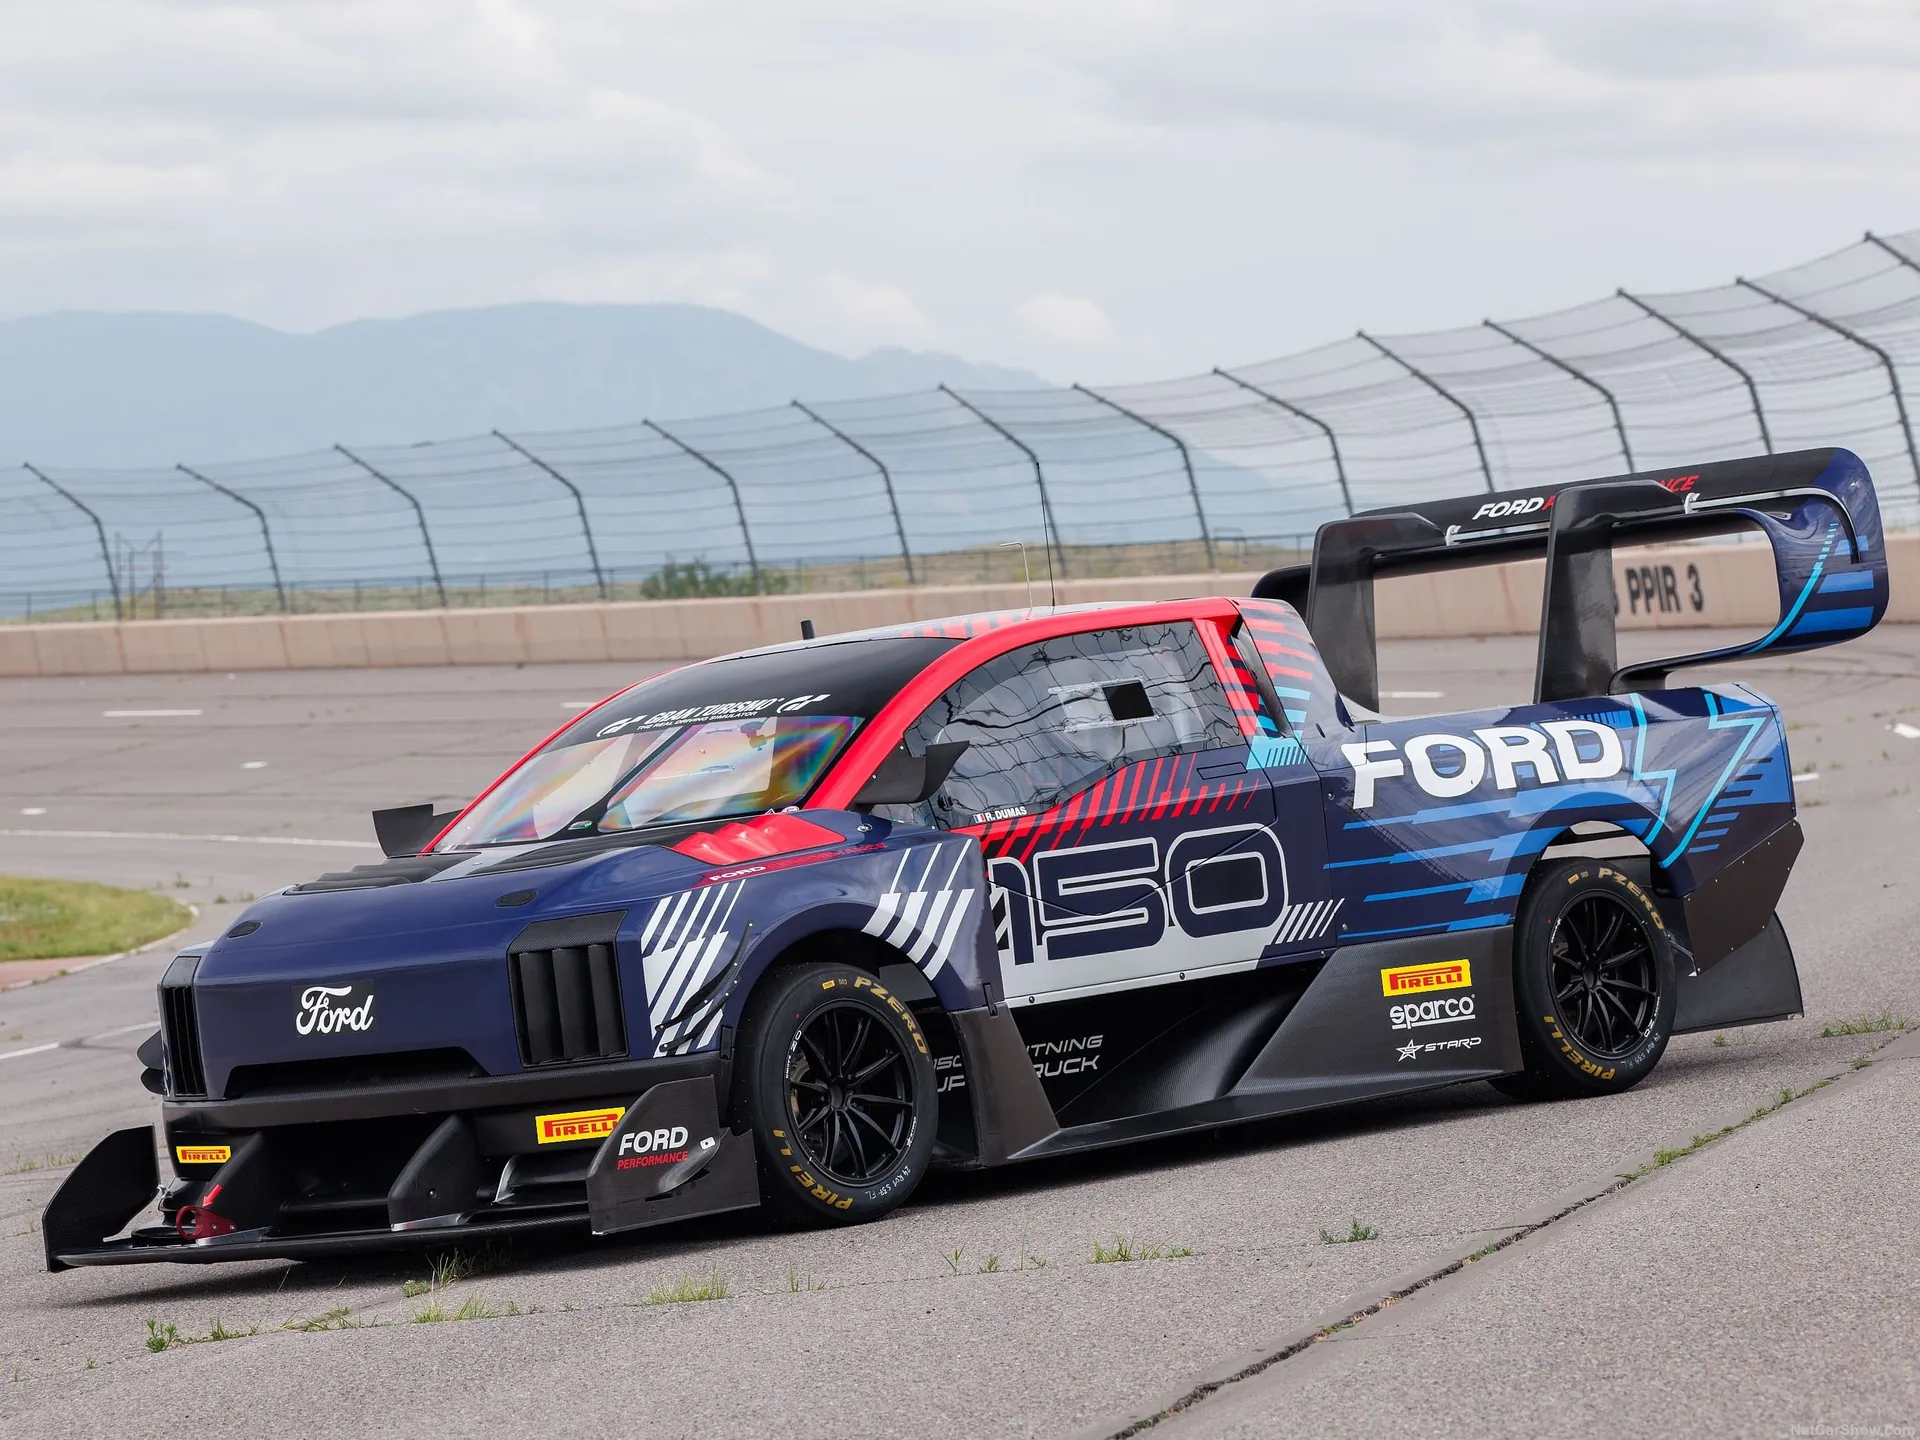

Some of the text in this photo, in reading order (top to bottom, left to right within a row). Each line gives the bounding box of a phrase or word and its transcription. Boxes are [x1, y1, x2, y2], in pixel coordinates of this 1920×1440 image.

[1472, 497, 1545, 520] FORD
[1625, 564, 1683, 614] PPIR
[1687, 563, 1704, 612] 3
[644, 698, 779, 725] GRAN TURISMO
[675, 716, 709, 724] DRIVING
[709, 711, 758, 720] SIMULATOR
[1341, 719, 1623, 810] FORD
[984, 806, 1028, 822] R. DUMAS
[708, 866, 766, 881] FORD
[1389, 965, 1463, 991] PIRELLI
[296, 985, 374, 1036] Ford
[1389, 996, 1475, 1030] sparco
[1424, 1037, 1482, 1052] STARD
[1544, 1016, 1616, 1080] PIRELLI
[618, 1126, 689, 1156] FORD
[181, 1150, 226, 1160] PIRELLI
[617, 1150, 689, 1170] PERFORMANCE
